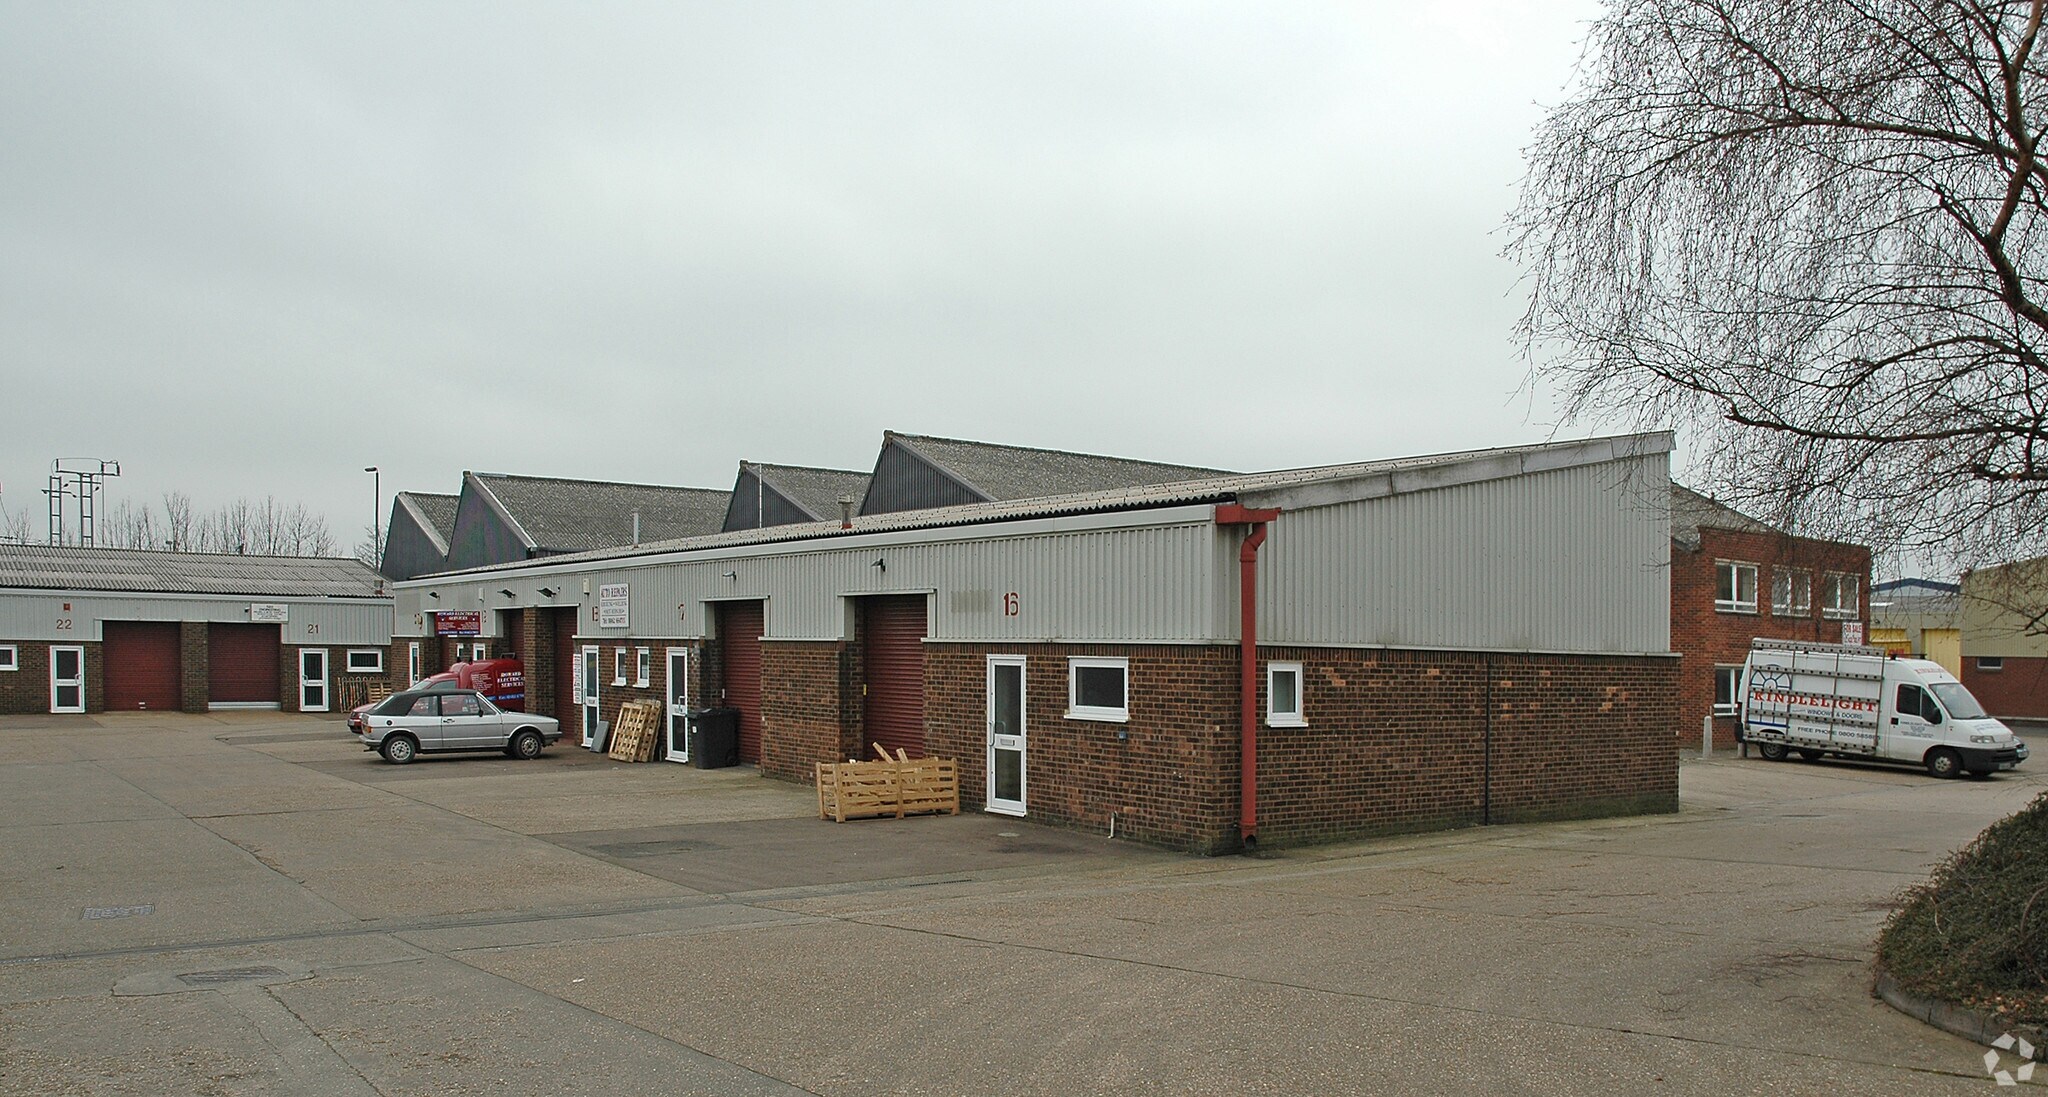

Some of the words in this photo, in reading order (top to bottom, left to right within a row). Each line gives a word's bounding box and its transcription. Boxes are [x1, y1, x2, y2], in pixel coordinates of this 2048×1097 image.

[1003, 592, 1019, 616] 16
[56, 618, 72, 630] 22
[307, 623, 319, 634] 21
[1754, 691, 1876, 712] KINDLELIGHT
[1807, 709, 1832, 717] WINDOW
